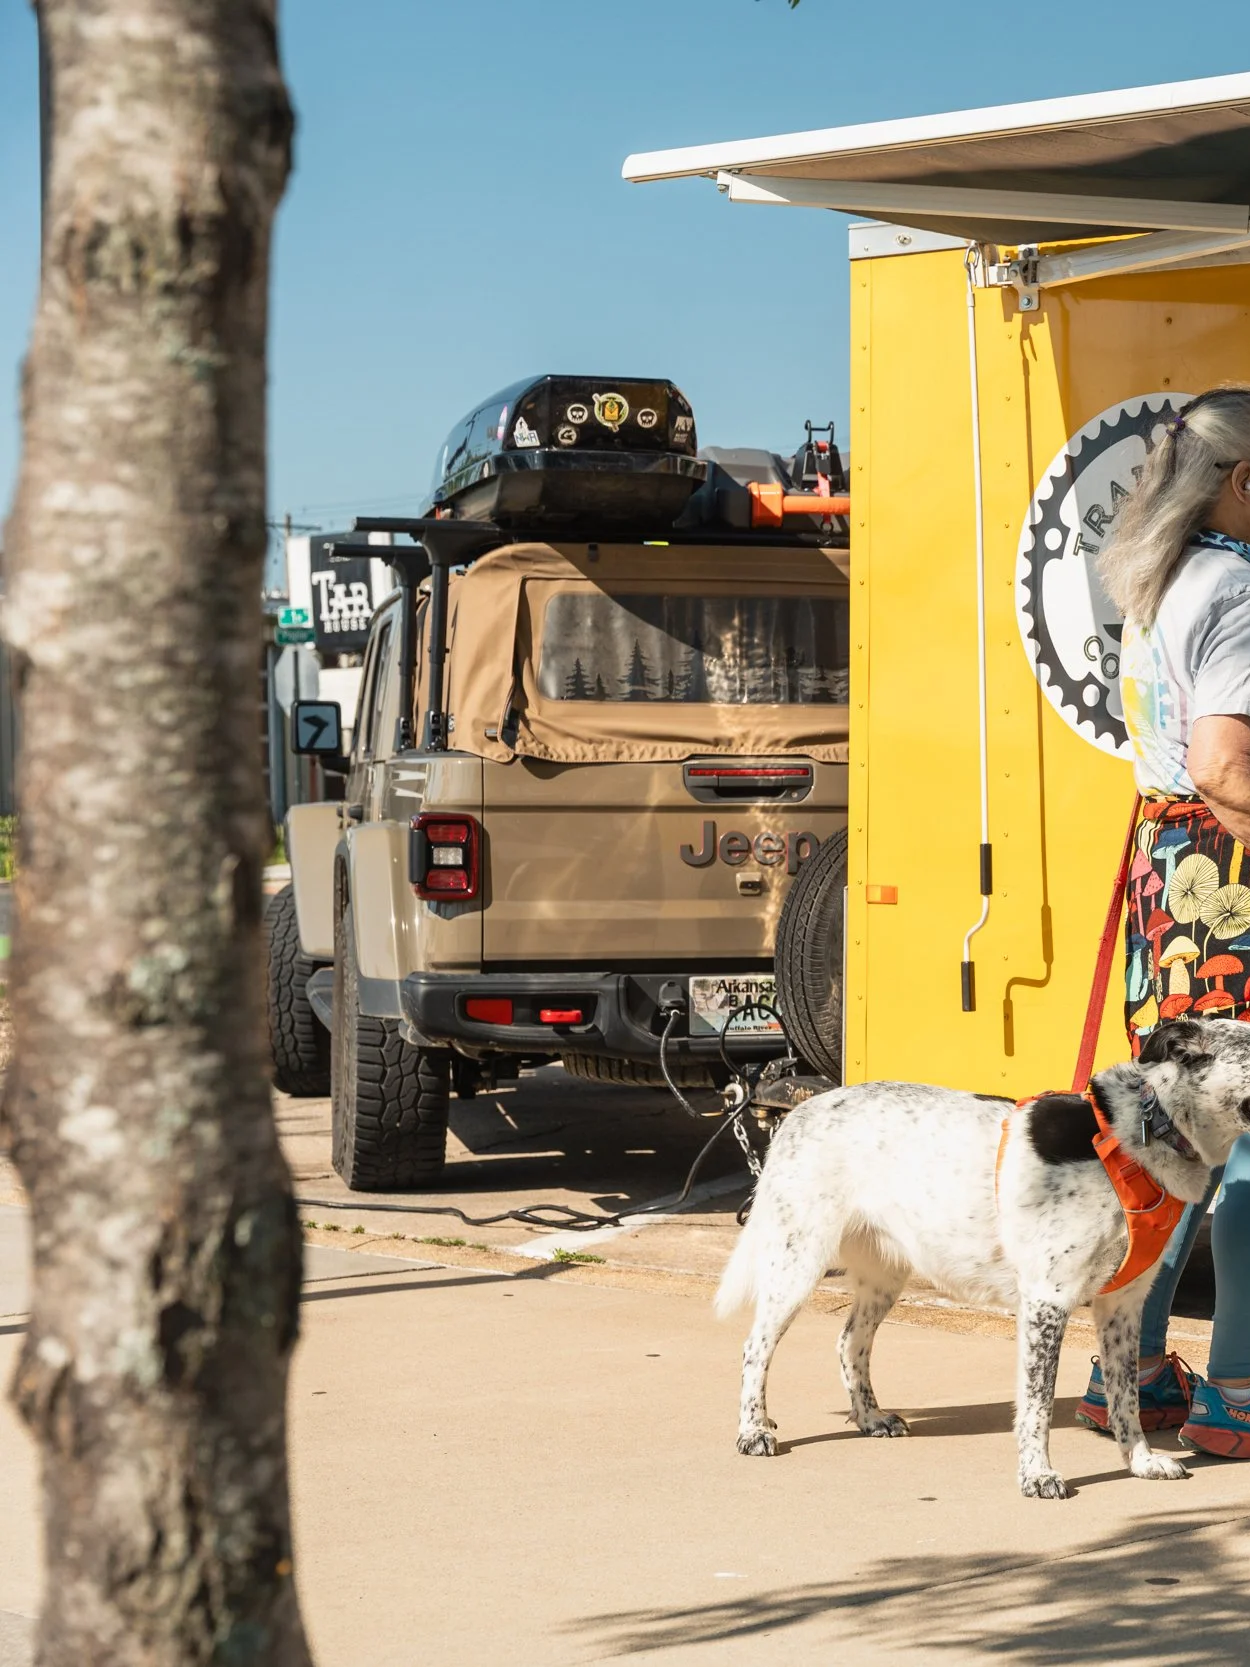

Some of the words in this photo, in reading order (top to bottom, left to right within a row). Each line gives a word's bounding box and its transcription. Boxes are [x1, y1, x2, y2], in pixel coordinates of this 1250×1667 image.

[312, 570, 373, 621] TAR
[324, 618, 367, 633] HOUSE
[680, 821, 820, 874] Jeep
